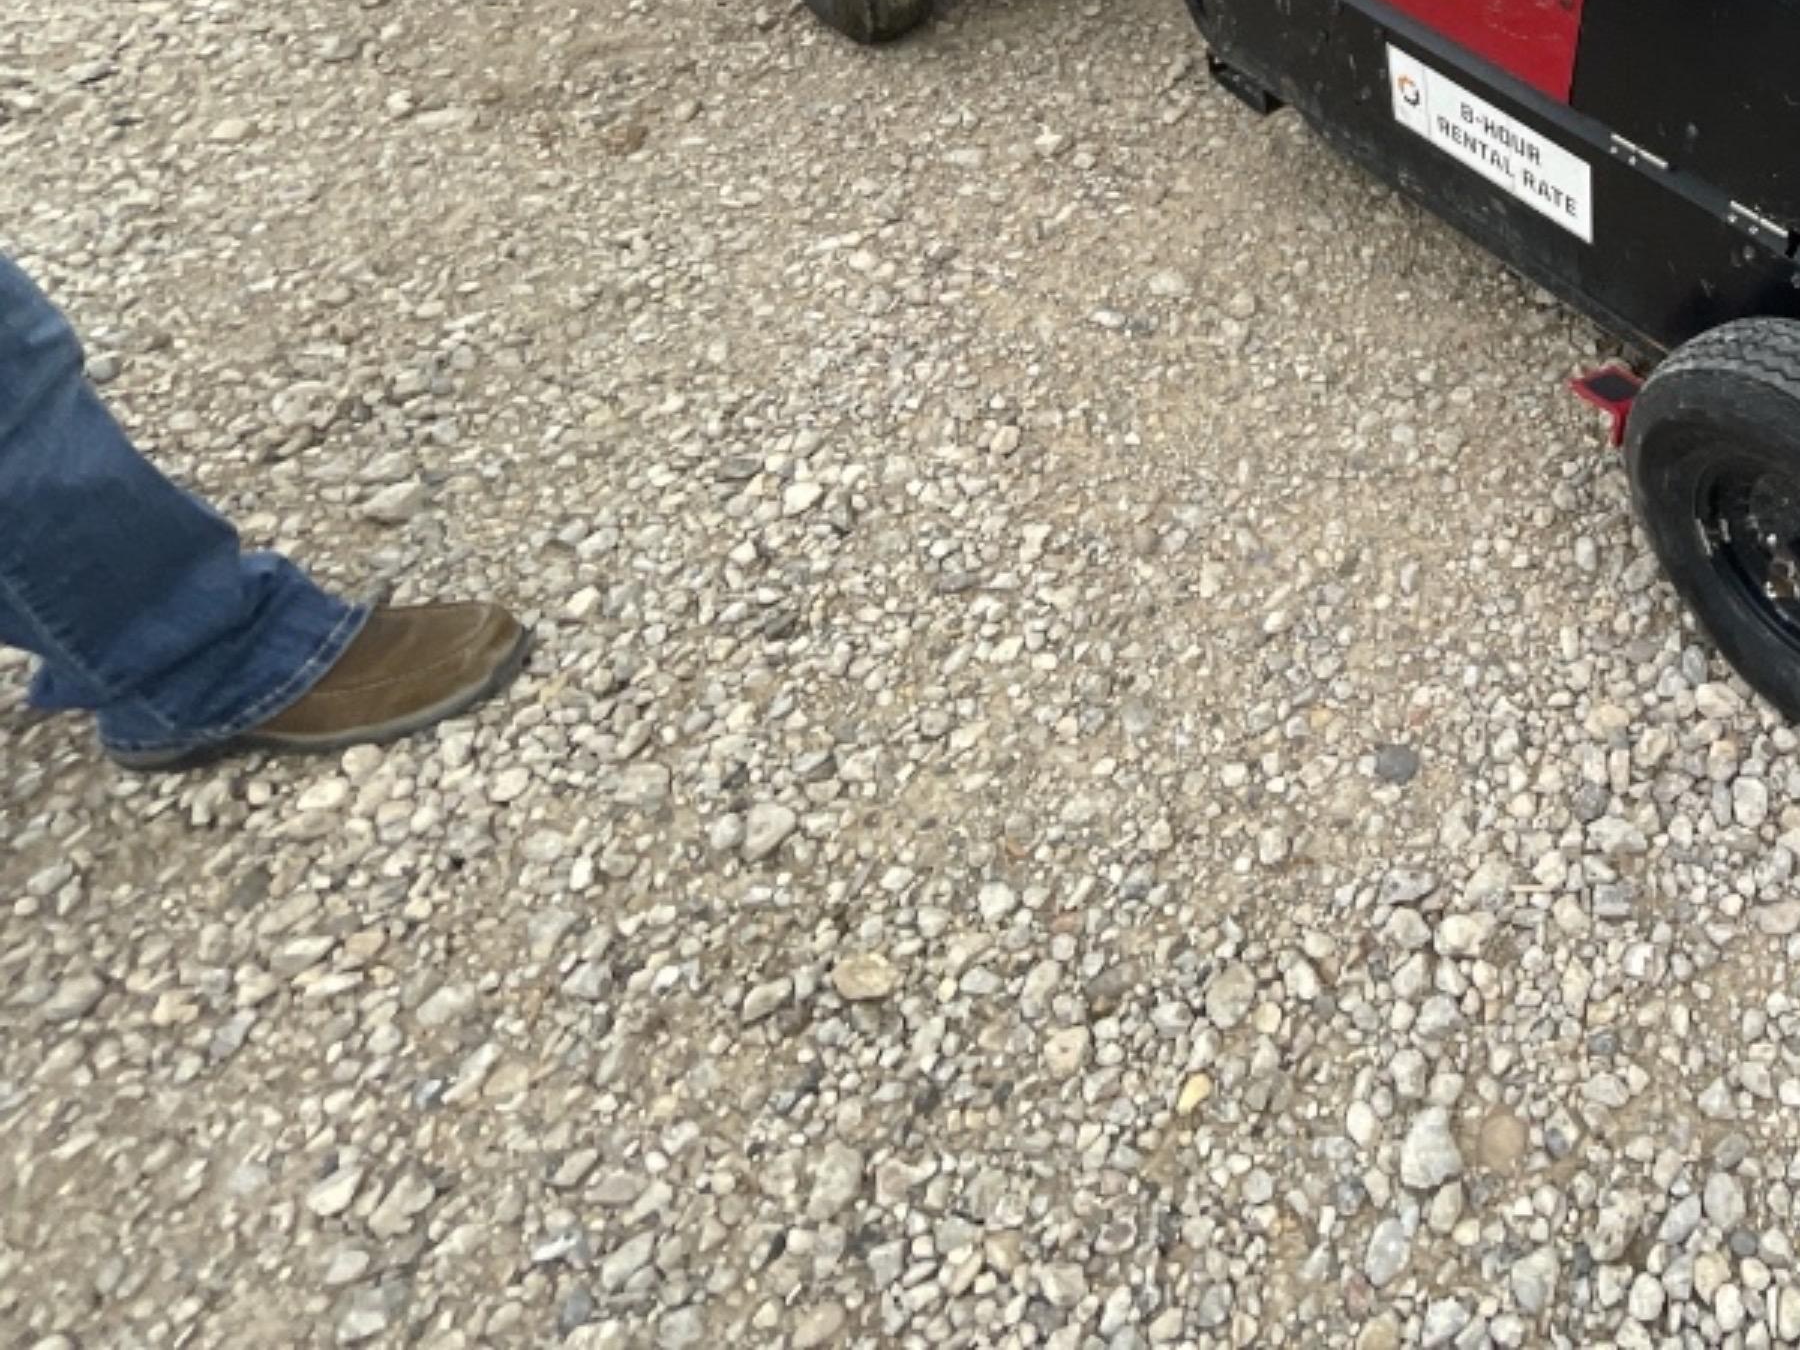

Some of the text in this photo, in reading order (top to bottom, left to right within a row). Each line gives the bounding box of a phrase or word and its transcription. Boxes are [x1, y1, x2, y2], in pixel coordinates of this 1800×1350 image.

[1437, 115, 1579, 218] RENTAL RATE
[1460, 100, 1541, 166] 8-HOUR
